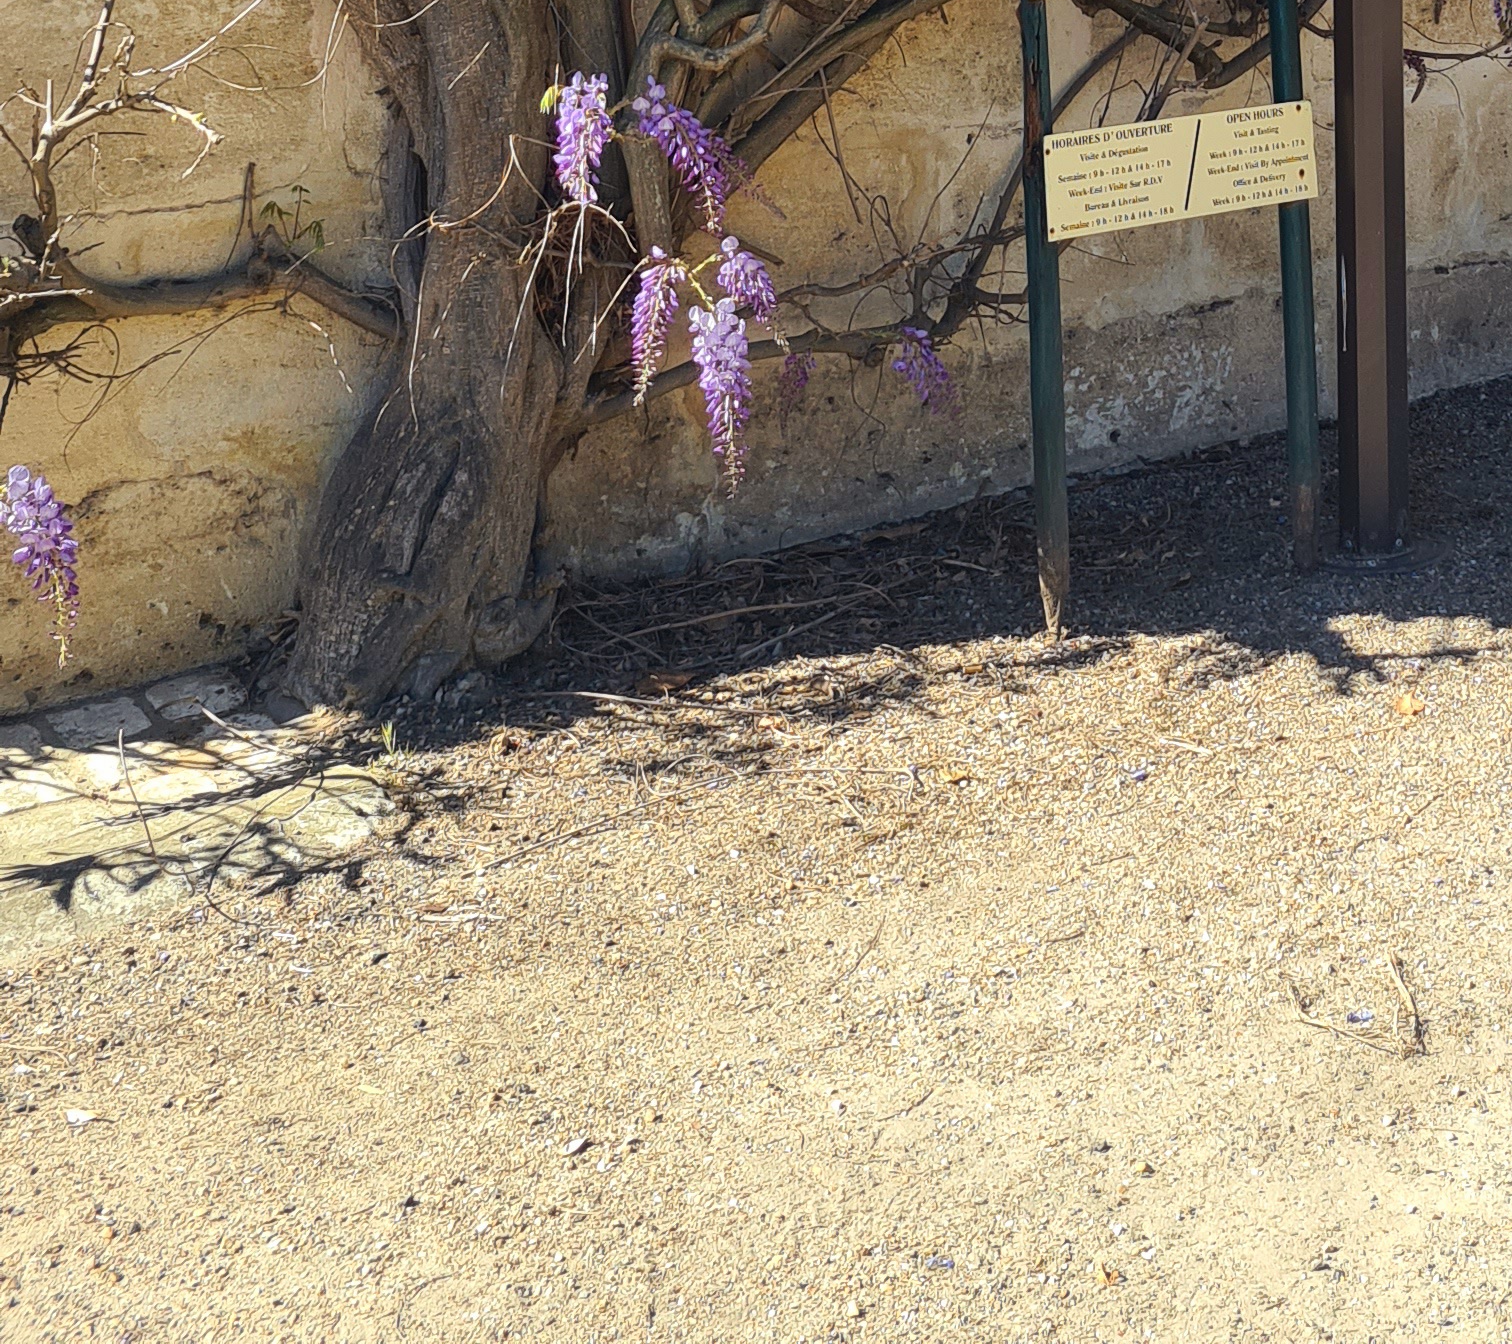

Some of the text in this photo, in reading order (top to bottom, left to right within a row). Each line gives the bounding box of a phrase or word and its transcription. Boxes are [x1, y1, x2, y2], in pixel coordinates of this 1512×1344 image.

[1227, 108, 1283, 123] OPEN HOURS
[1052, 134, 1100, 149] HORAIRES
[1234, 130, 1248, 138] Visit
[1250, 146, 1257, 154] 12
[1272, 142, 1279, 150] 14
[1292, 139, 1299, 147] 17
[1111, 167, 1119, 175] 12
[1136, 163, 1143, 171] 14
[1157, 160, 1165, 168] 17
[1253, 192, 1260, 200] 12
[1275, 188, 1282, 196] 14
[1114, 215, 1122, 223] 12
[1138, 211, 1146, 219] 14
